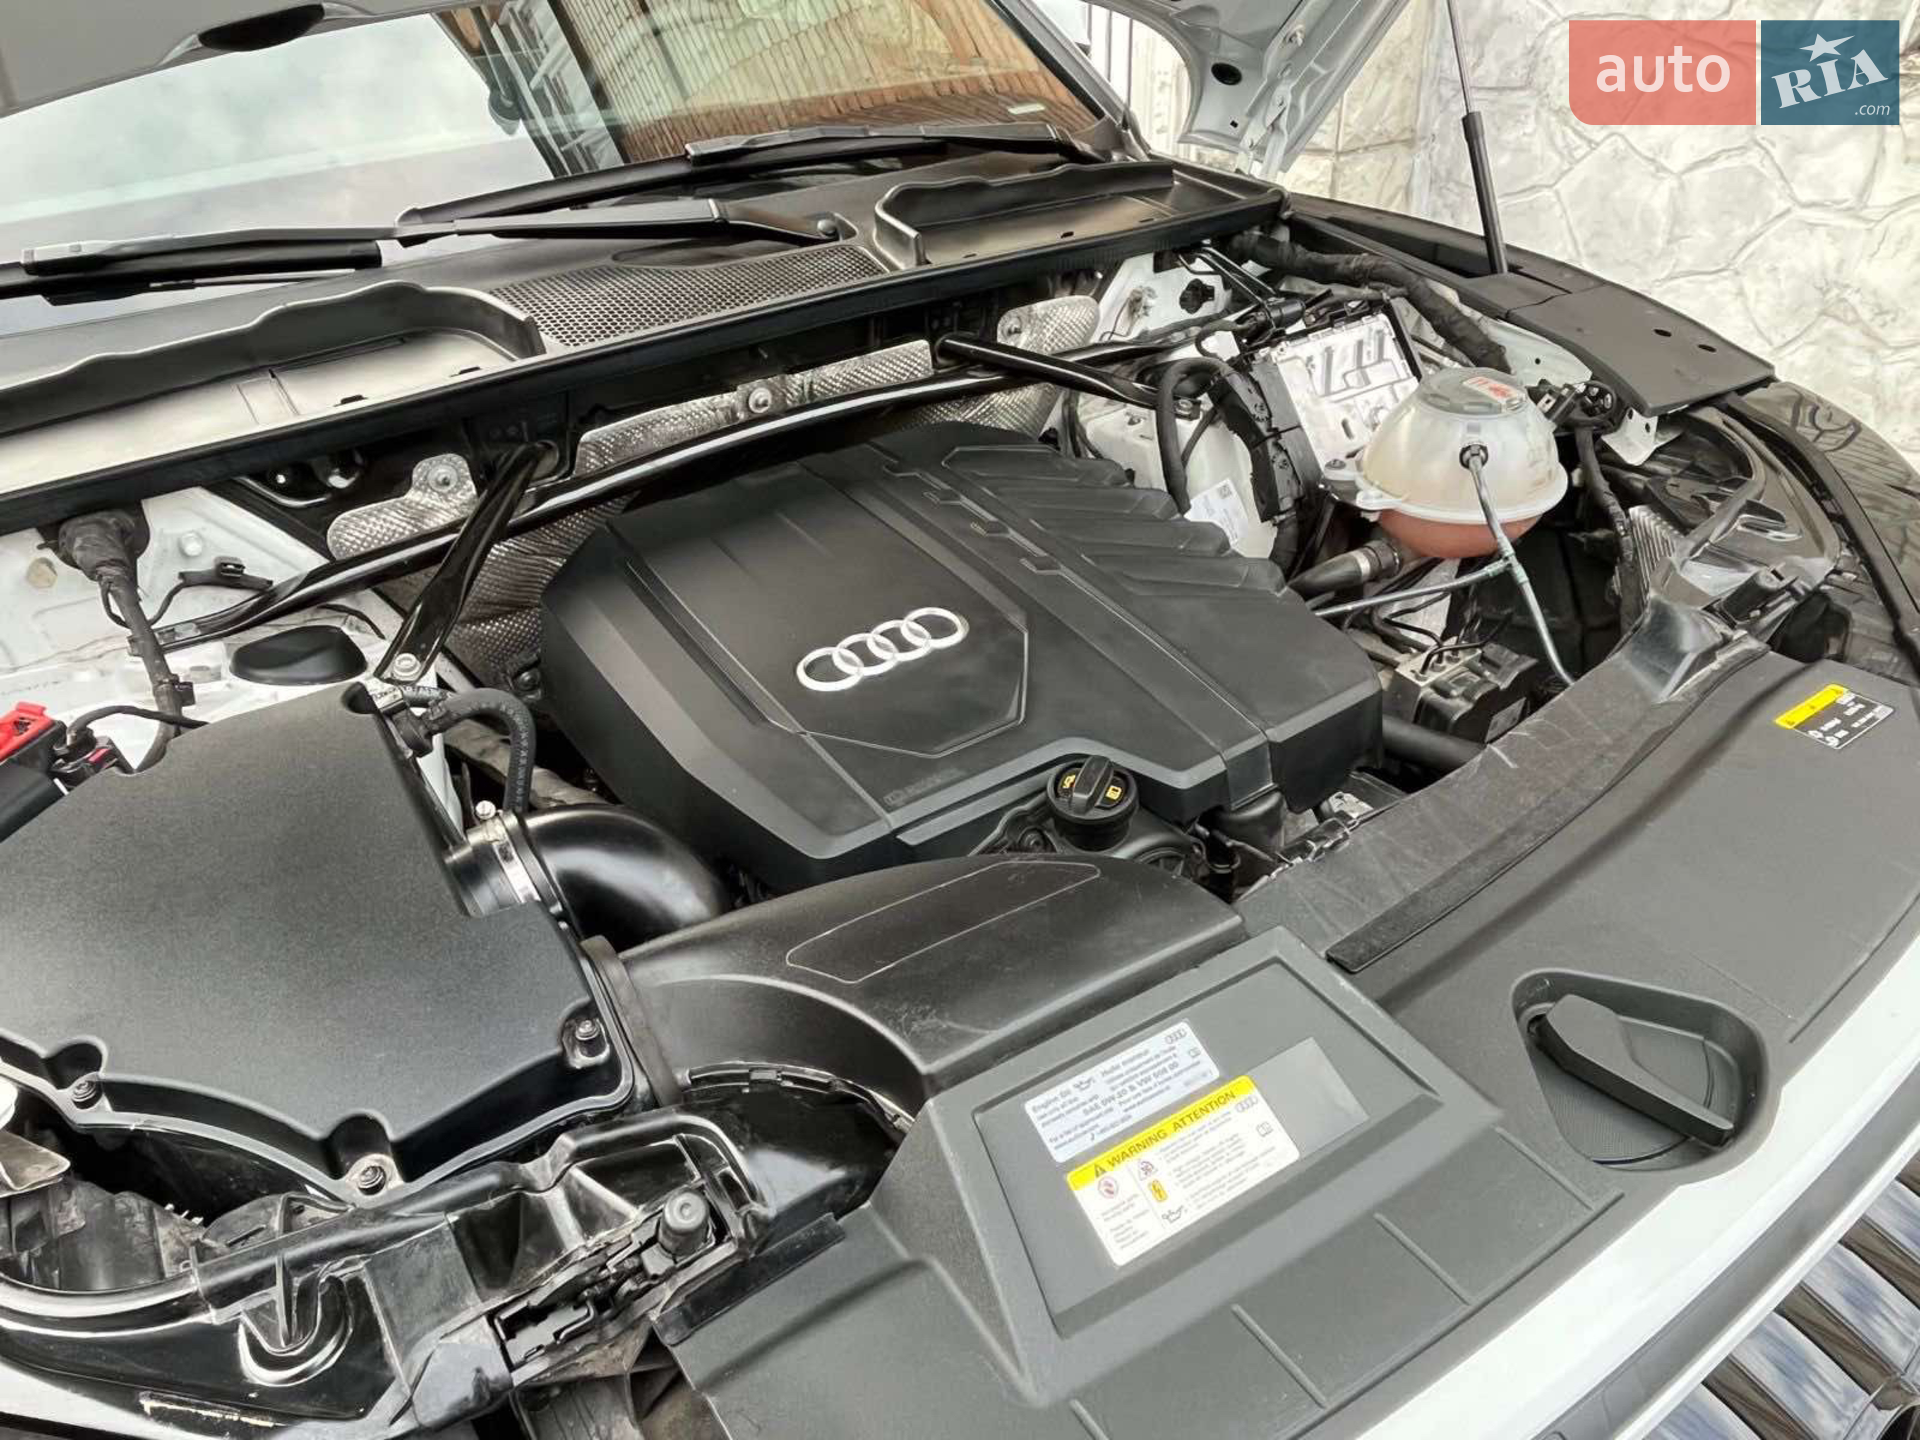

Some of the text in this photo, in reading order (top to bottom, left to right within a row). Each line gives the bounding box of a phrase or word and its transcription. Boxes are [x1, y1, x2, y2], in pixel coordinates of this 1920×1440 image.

[1082, 1101, 1101, 1115] SAE
[1107, 1128, 1168, 1167] WARNING
[1172, 1090, 1236, 1132] ATTENTION
